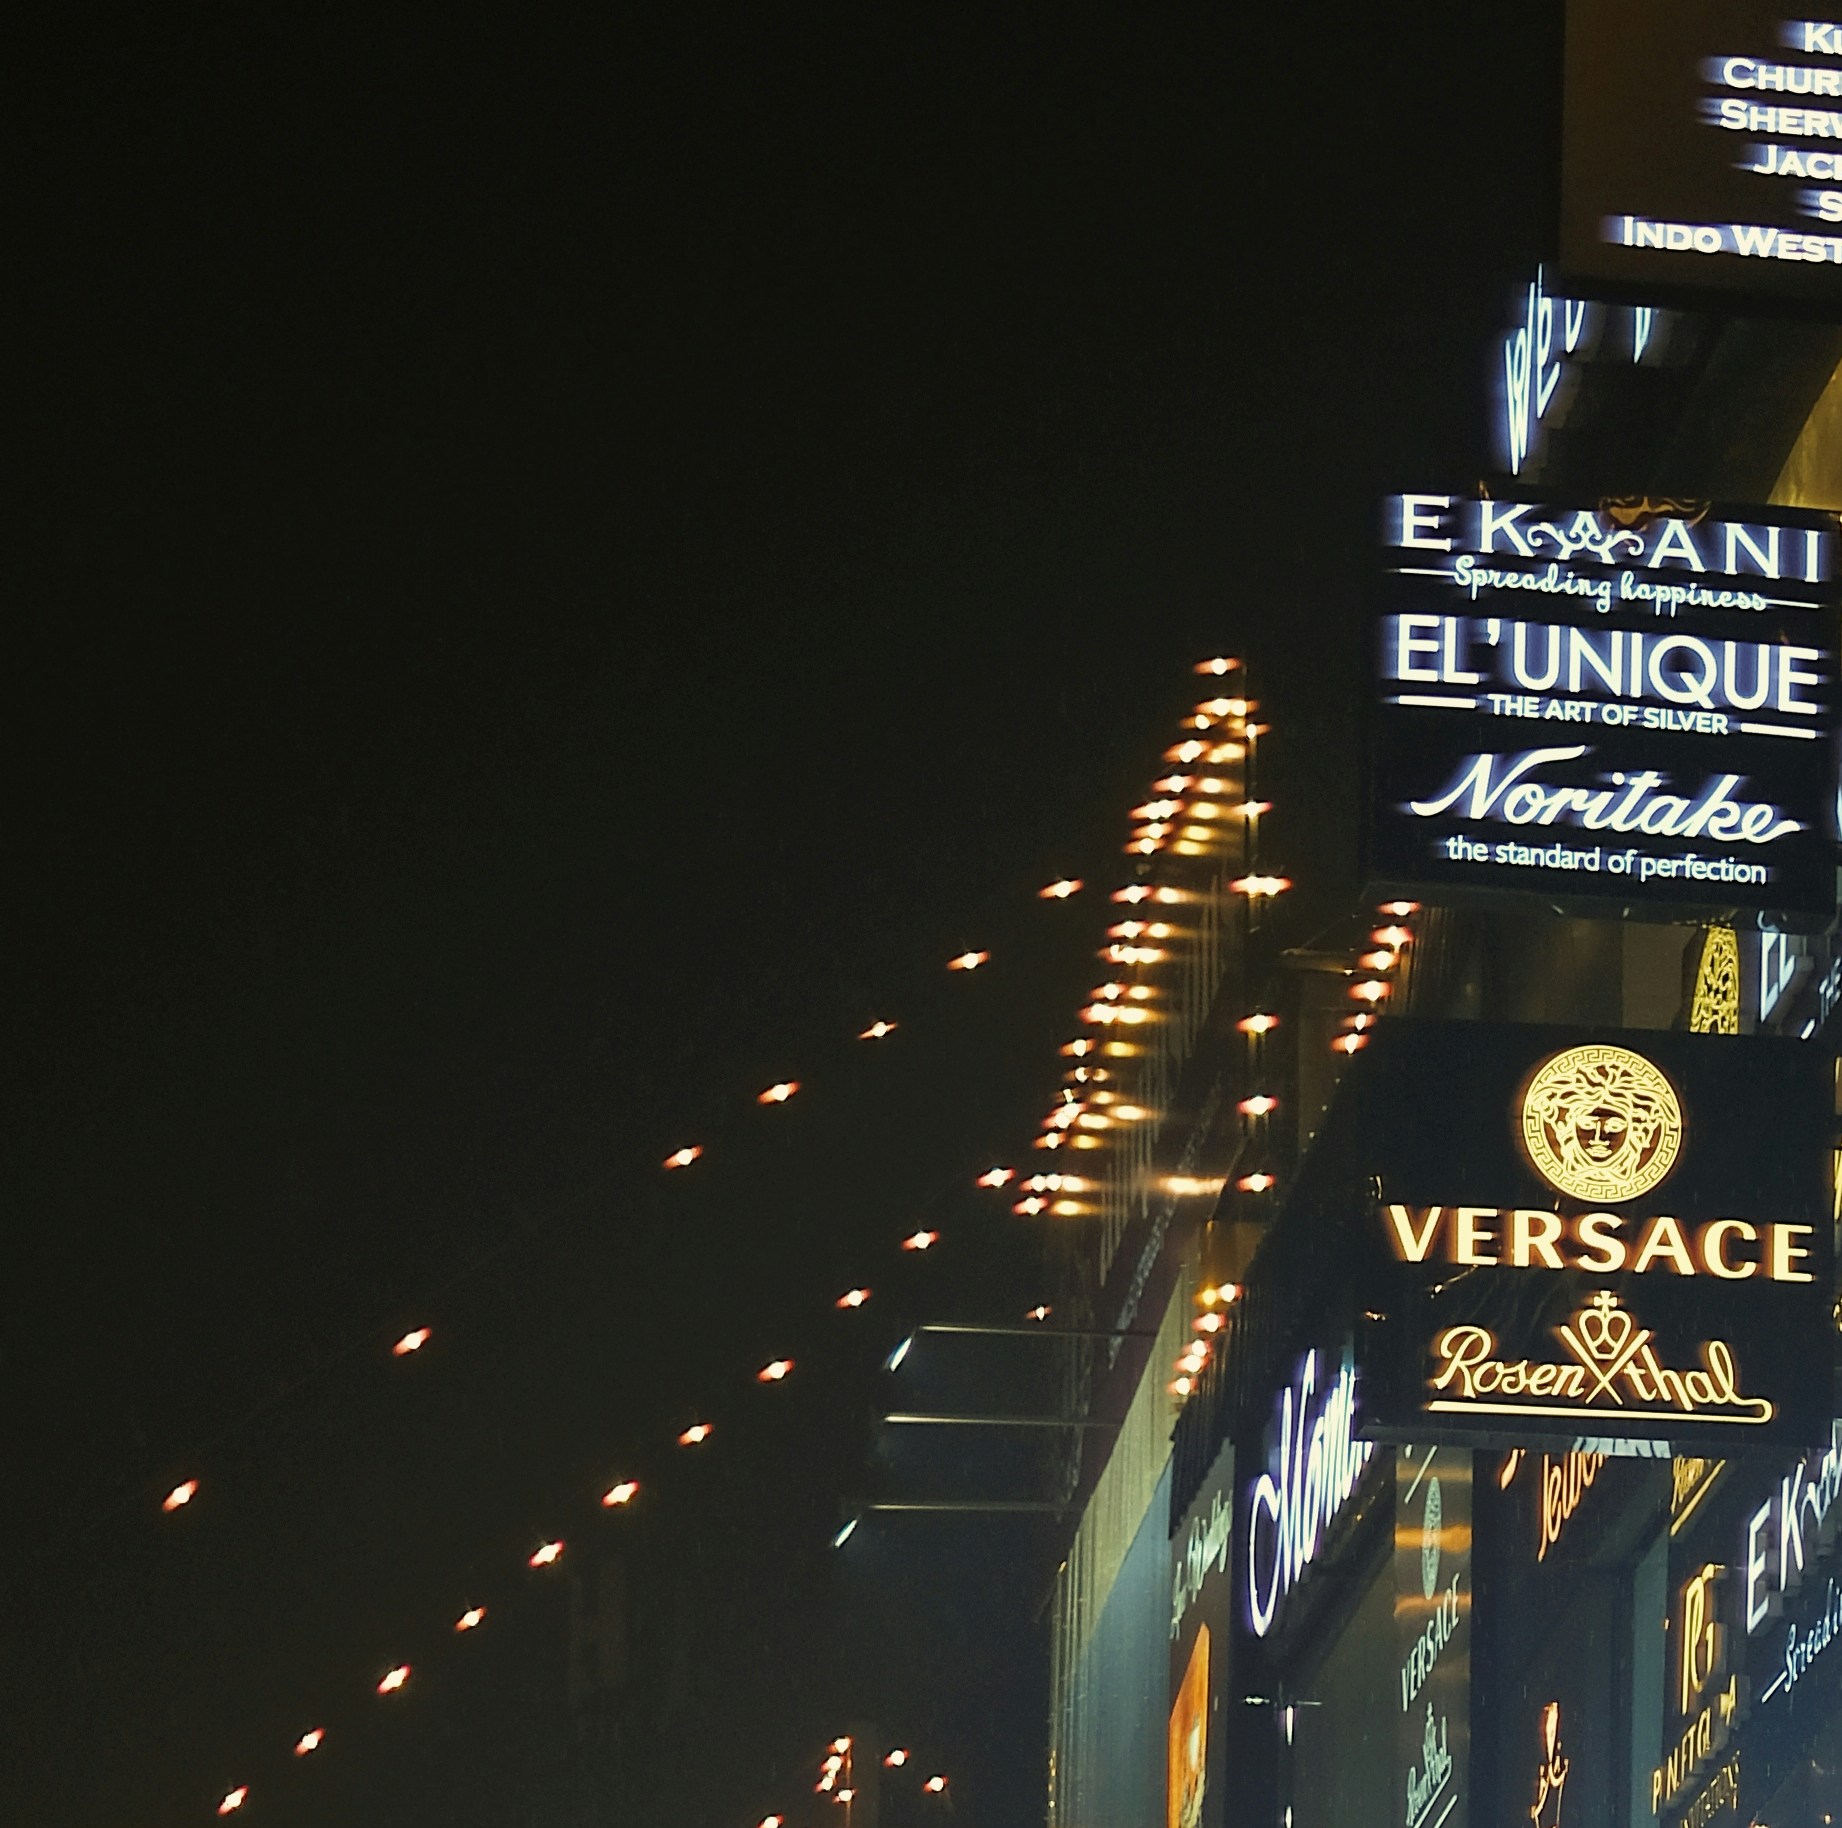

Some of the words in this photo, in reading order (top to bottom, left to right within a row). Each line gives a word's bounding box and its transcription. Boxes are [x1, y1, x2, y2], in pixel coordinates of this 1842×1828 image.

[1452, 554, 1611, 613] Spreading
[1618, 571, 1769, 617] happiness
[1399, 614, 1819, 715] EL'UNIQUE
[1488, 693, 1539, 720] THE
[1545, 698, 1598, 724] ART
[1601, 703, 1638, 726] OF
[1643, 707, 1729, 736] SILVER
[1410, 745, 1801, 842] Noritake
[1446, 835, 1489, 863] the
[1495, 838, 1600, 872] standard
[1607, 847, 1638, 875] of
[1640, 850, 1767, 886] perfection
[1388, 1204, 1816, 1284] VERSACE
[1401, 1572, 1461, 1713] VERSACE
